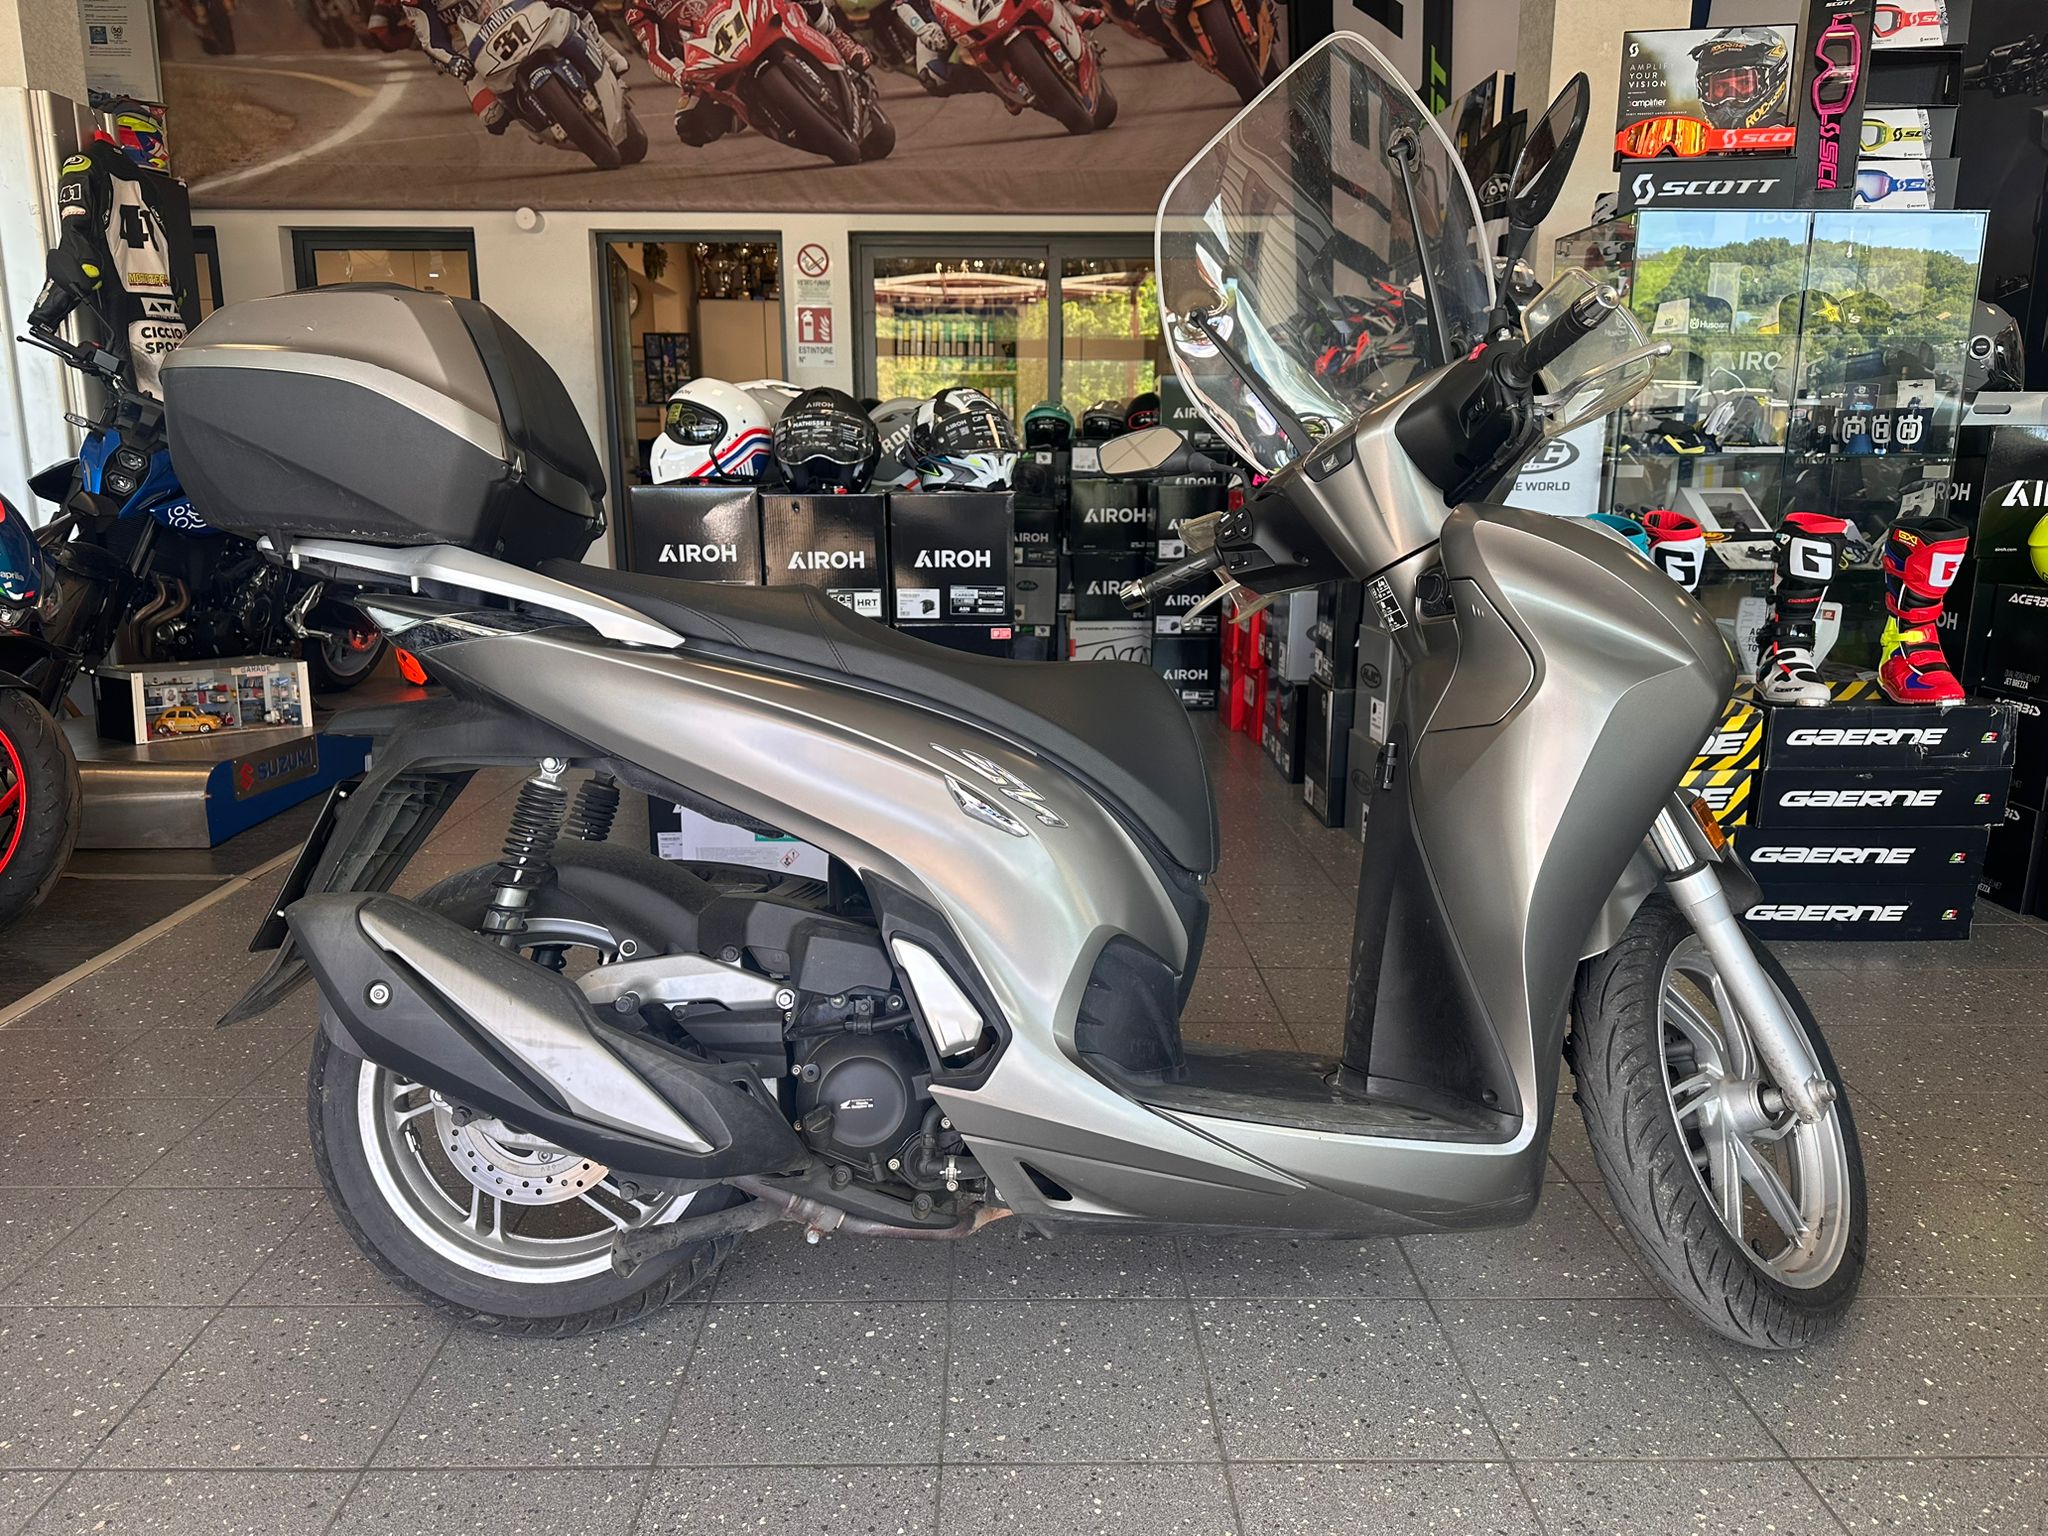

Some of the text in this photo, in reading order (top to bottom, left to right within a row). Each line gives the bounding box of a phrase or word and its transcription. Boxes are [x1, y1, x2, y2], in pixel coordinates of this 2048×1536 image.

[478, 5, 516, 42] WinWin
[493, 20, 532, 61] 31
[714, 12, 748, 57] 41
[1629, 63, 1674, 71] AMPLIF
[1628, 80, 1667, 88] VISION
[1629, 72, 1658, 80] YOUR
[1631, 98, 1667, 108] amplifier
[60, 184, 82, 202] 41
[1656, 178, 1782, 196] SCOTT
[119, 204, 160, 251] 41
[141, 327, 183, 339] CICCIO
[798, 346, 833, 354] ESTINTORE
[1525, 482, 1570, 491] WORLD
[1084, 508, 1147, 523] AIROH
[659, 544, 737, 562] AIROH
[788, 551, 865, 569] AIROH
[915, 550, 991, 568] AIROH
[1790, 537, 1833, 580] G
[857, 599, 878, 607] HRT
[240, 665, 272, 673] GARAGE
[1163, 669, 1208, 680] AIROH
[1787, 728, 1948, 746] GAERNE
[257, 750, 314, 780] SUZUKI
[1778, 790, 1943, 807] GAERNE
[1750, 847, 1916, 864] GAERNE
[1745, 905, 1909, 922] GAERNE
